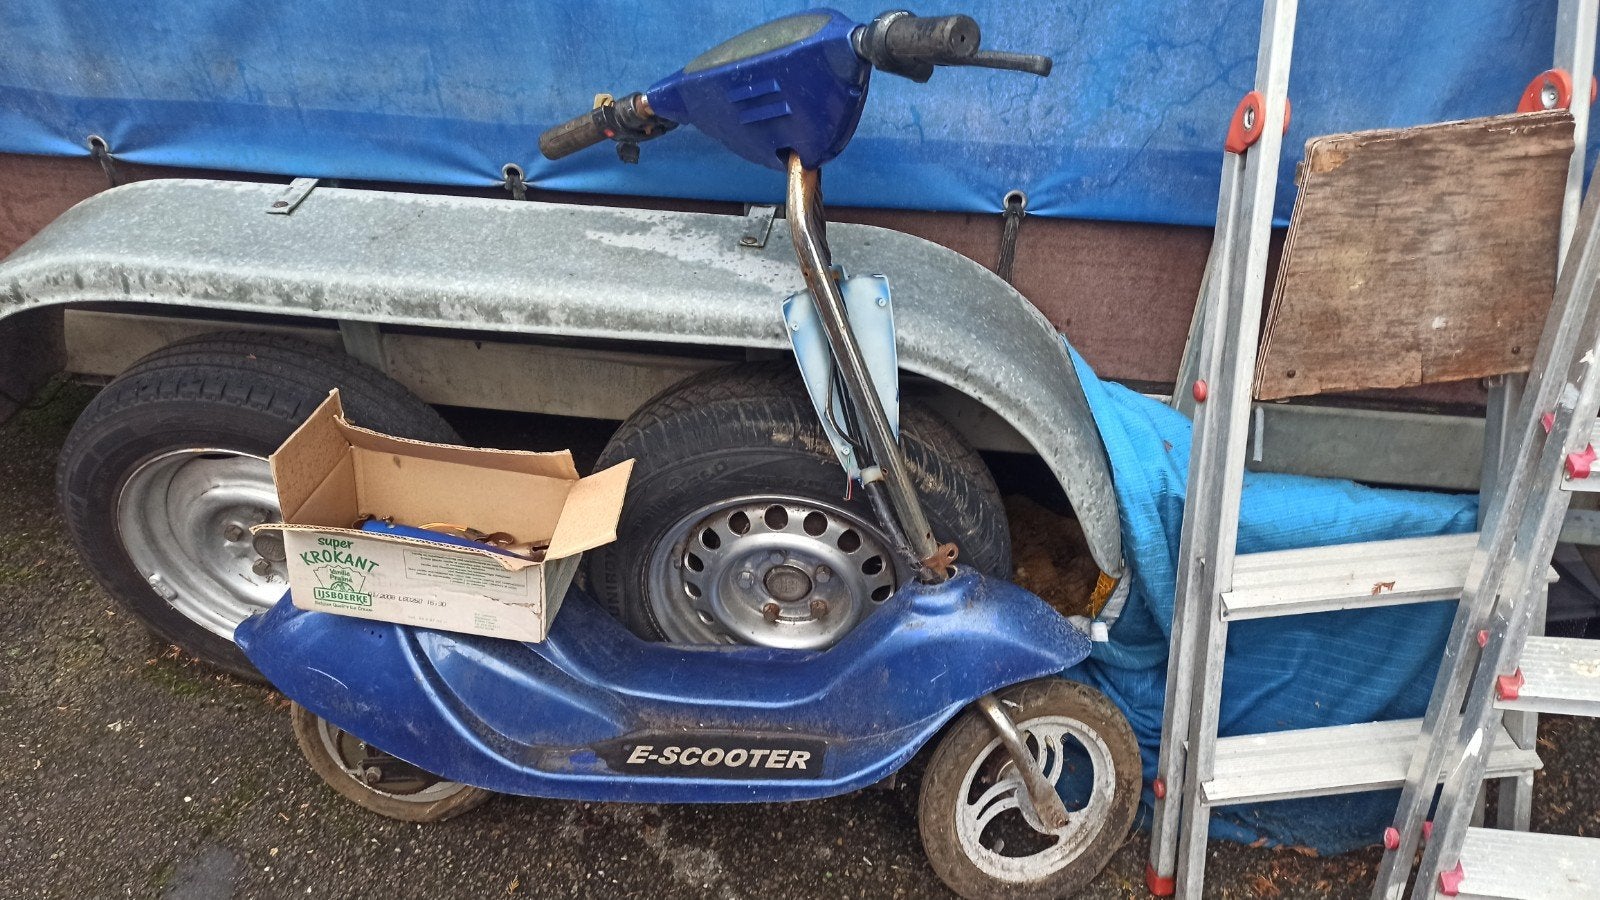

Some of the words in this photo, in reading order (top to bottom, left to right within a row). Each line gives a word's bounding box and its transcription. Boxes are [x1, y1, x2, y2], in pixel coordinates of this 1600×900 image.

[318, 537, 354, 550] super
[300, 549, 379, 573] KROKANT
[317, 589, 368, 604] IJSBOERKE
[626, 745, 811, 770] E-SCOOTER
